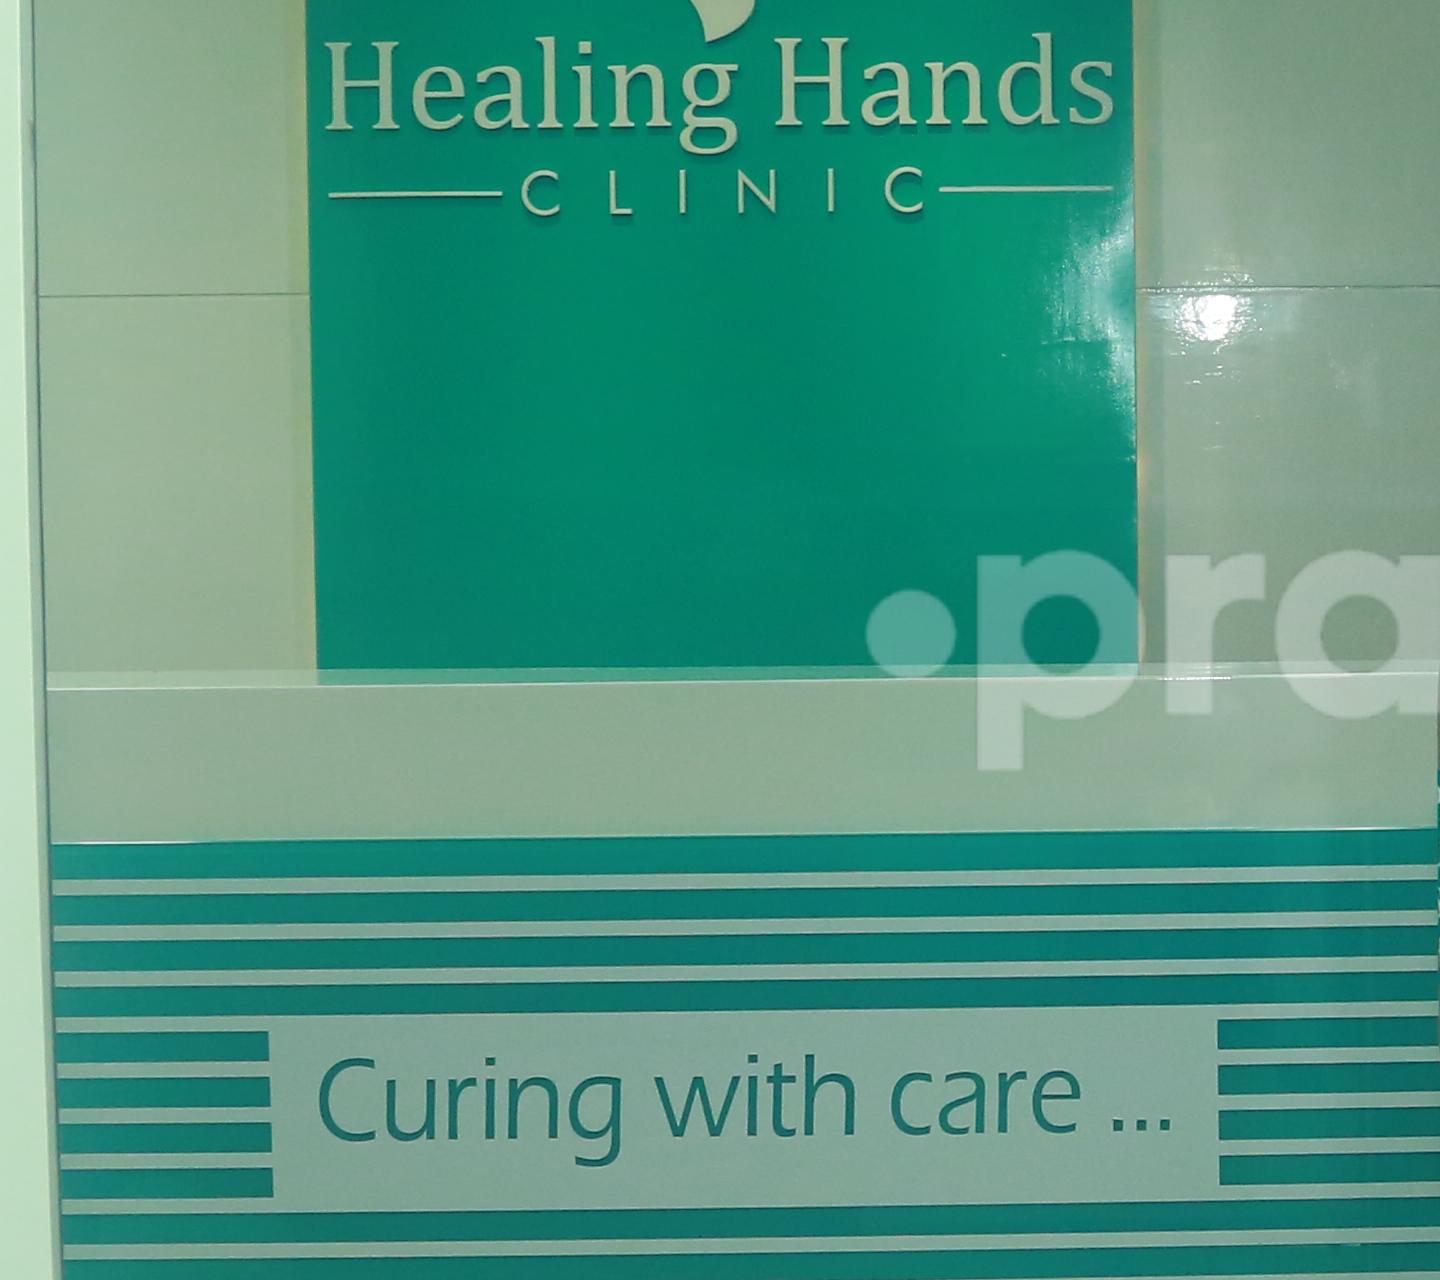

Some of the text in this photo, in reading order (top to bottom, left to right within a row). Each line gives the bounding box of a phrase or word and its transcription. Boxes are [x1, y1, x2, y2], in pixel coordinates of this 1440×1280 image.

[325, 32, 1115, 155] Healing Hands
[521, 166, 923, 220] CLINIC
[319, 1057, 622, 1168] Curing
[654, 1054, 855, 1138] with
[891, 1070, 1081, 1136] care
